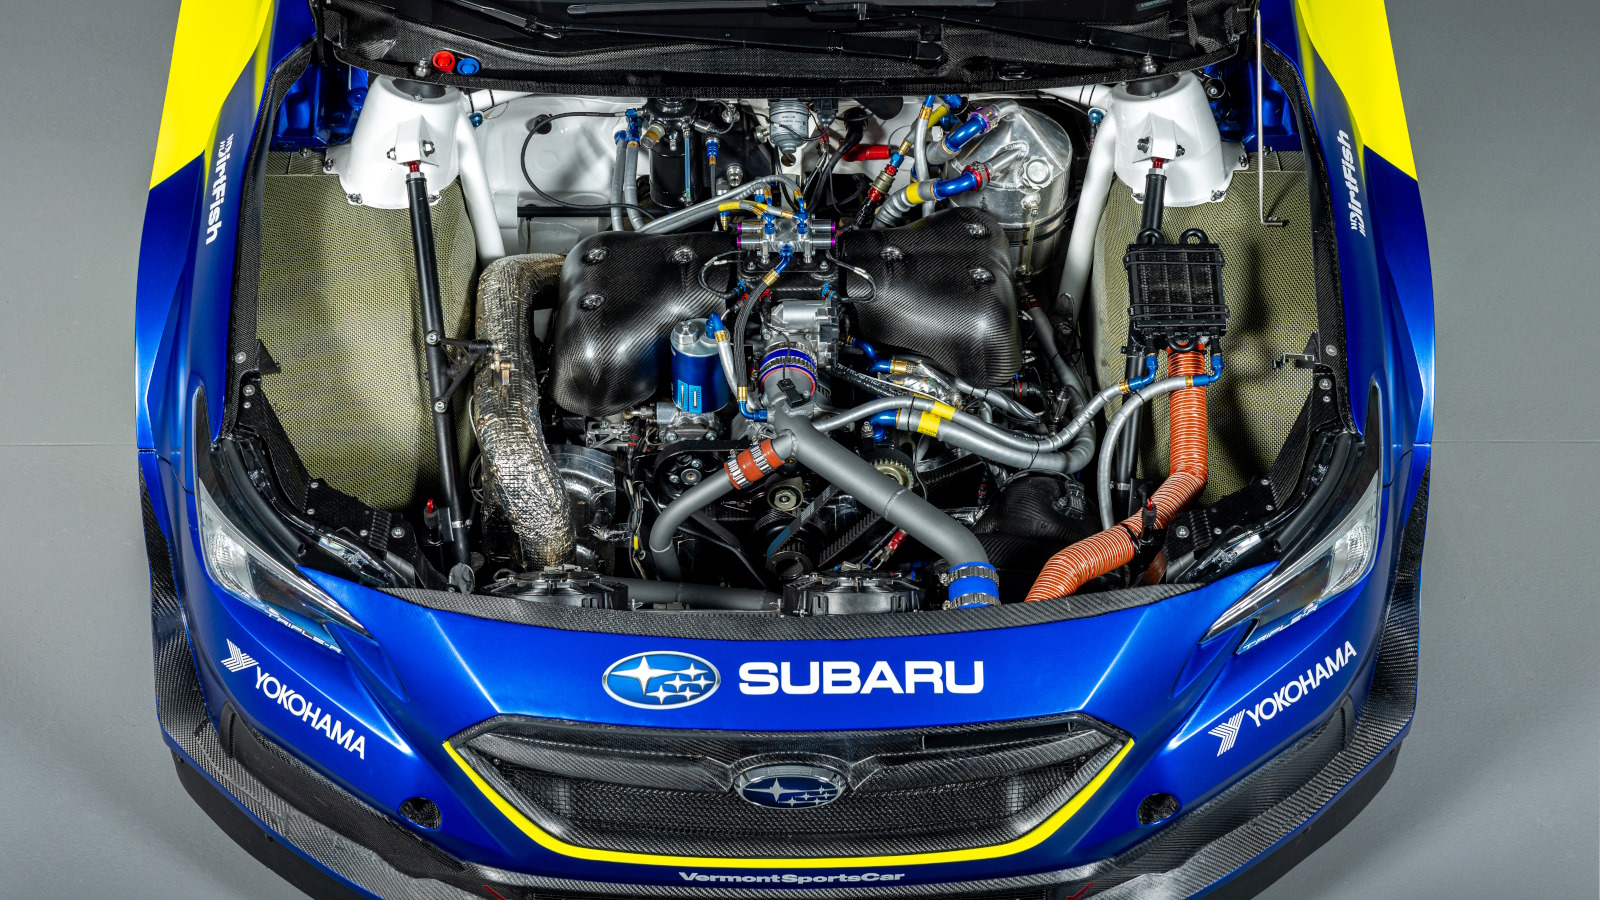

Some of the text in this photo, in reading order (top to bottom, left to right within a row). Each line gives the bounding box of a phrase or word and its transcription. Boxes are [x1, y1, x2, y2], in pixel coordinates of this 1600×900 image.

[254, 666, 367, 760] YOKOHAMA
[738, 660, 984, 695] SUBARU
[1246, 640, 1358, 727] YOKOHAMA
